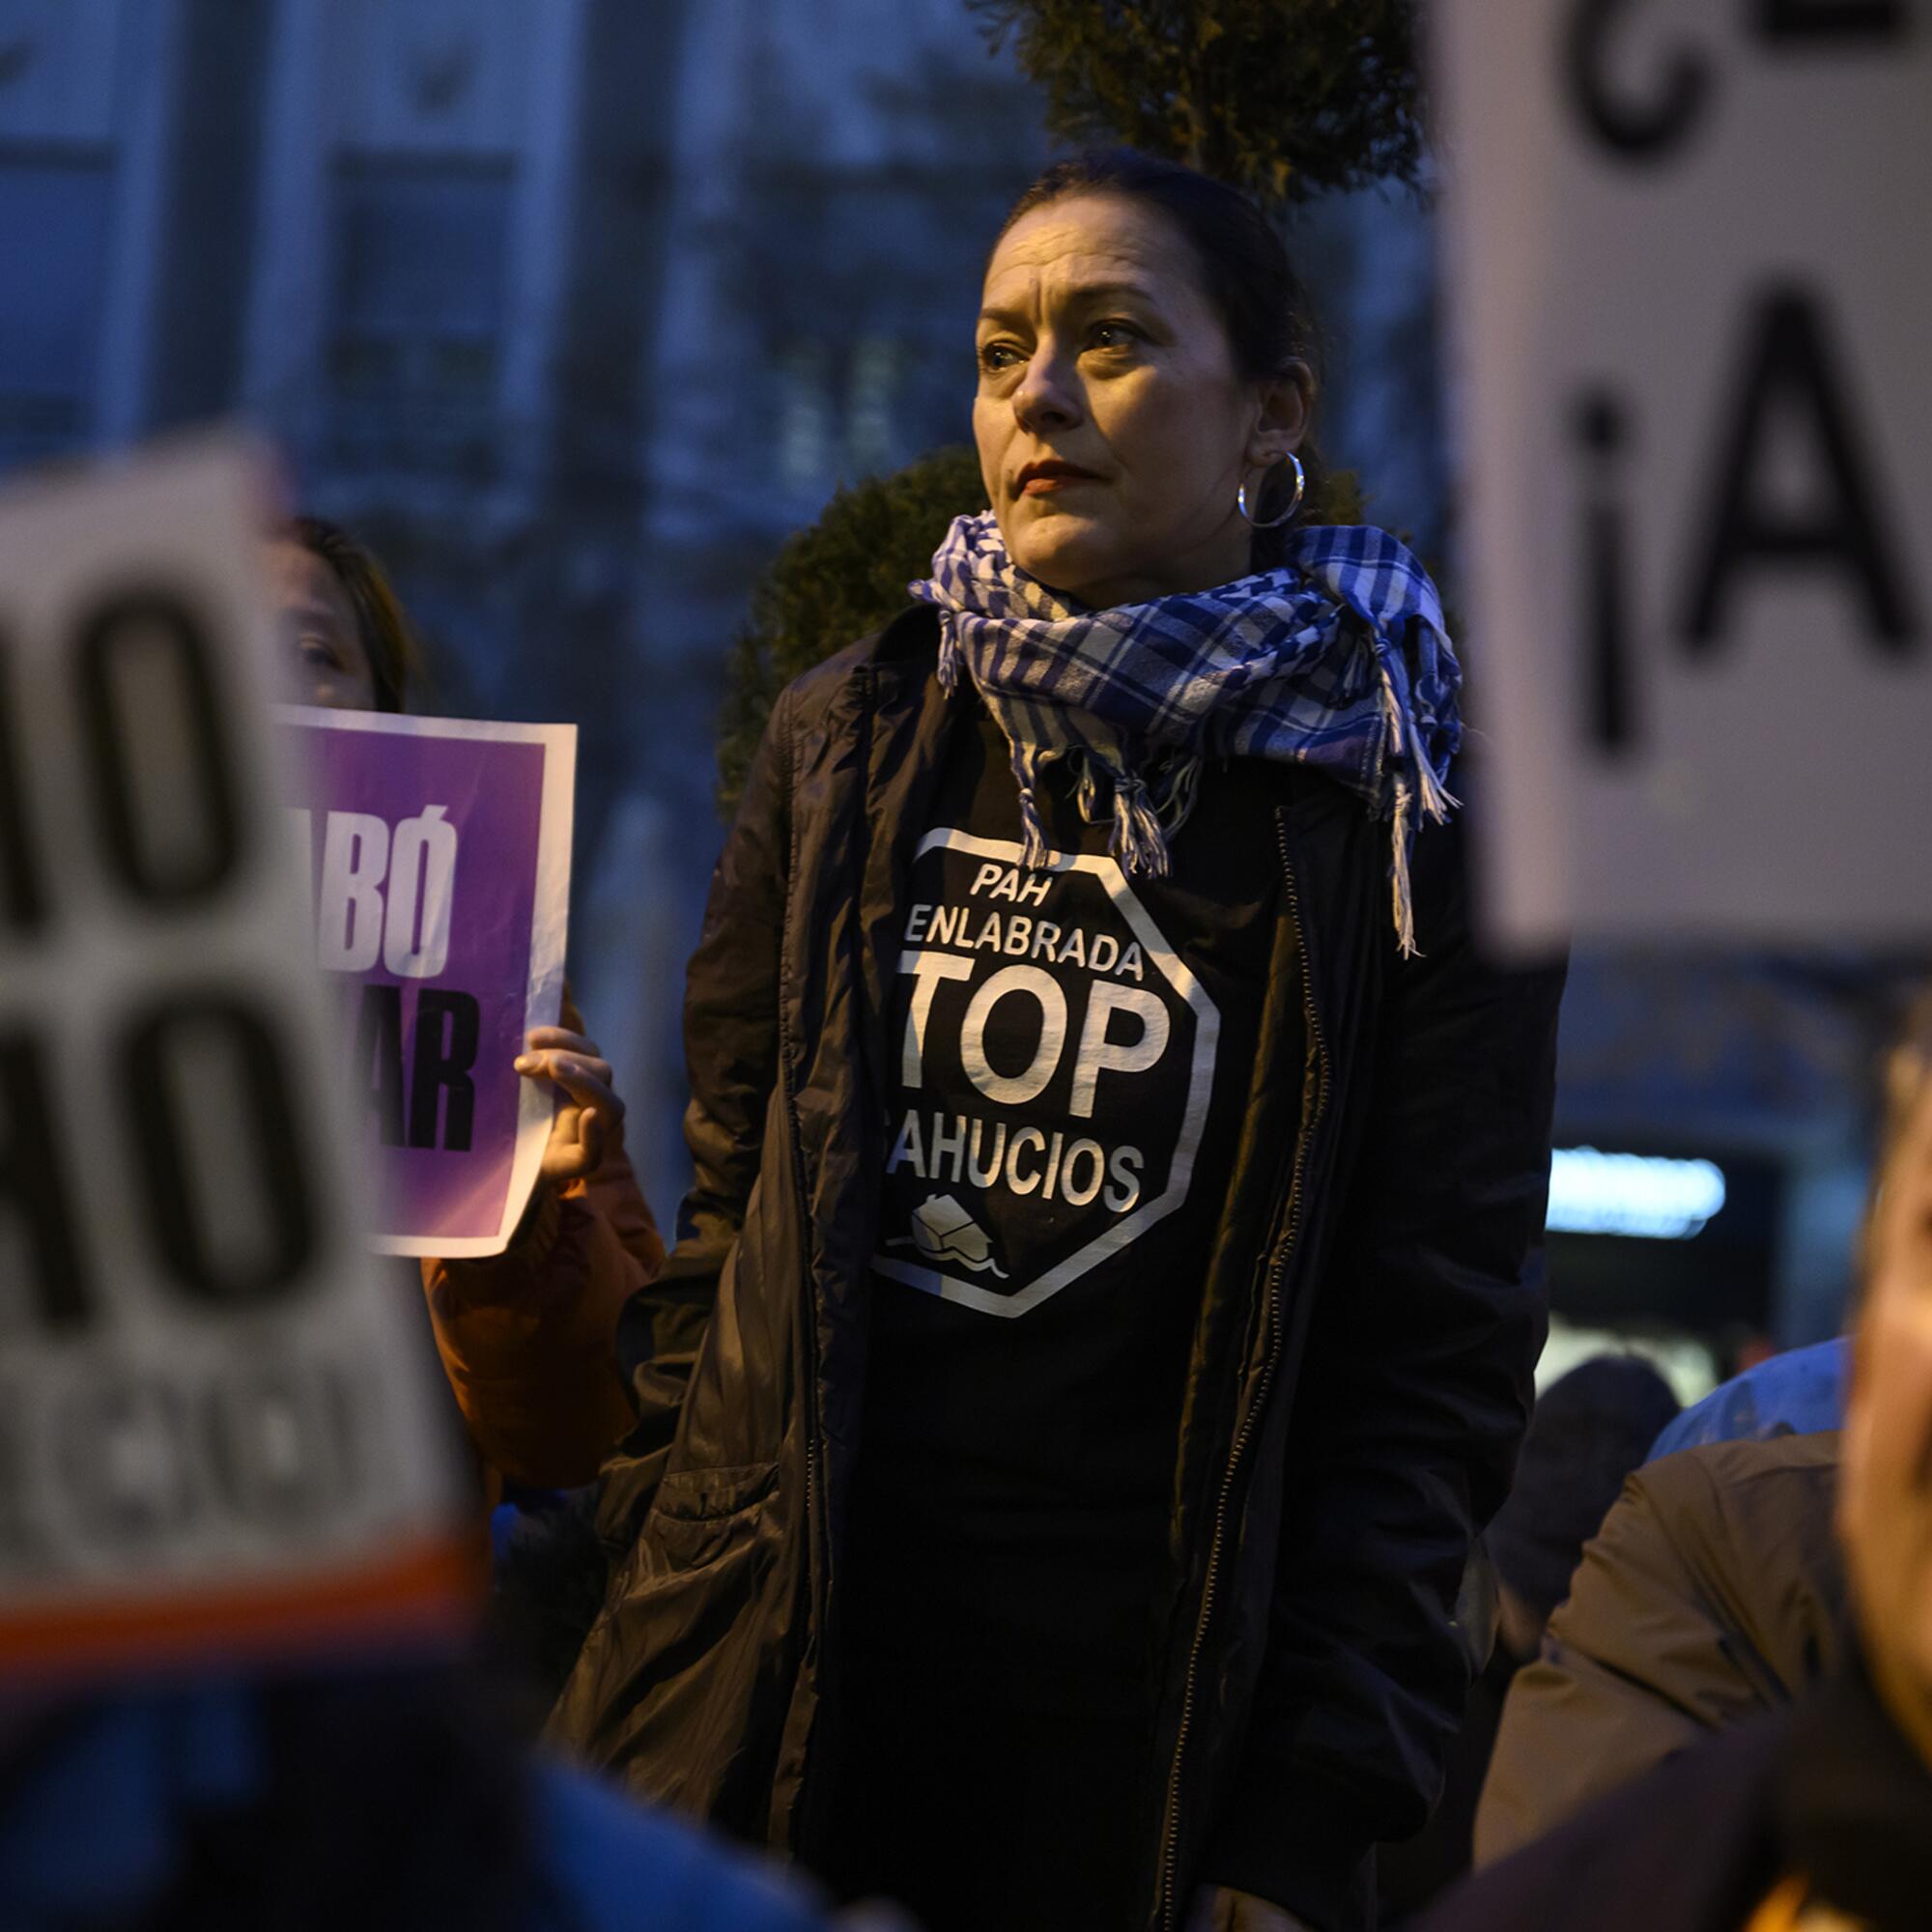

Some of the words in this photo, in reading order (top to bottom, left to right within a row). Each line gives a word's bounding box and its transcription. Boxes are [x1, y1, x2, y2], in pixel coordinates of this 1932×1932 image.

[969, 863, 1052, 906] PAH
[904, 903, 1144, 981] ENLABRADA
[896, 950, 1171, 1120] TOP
